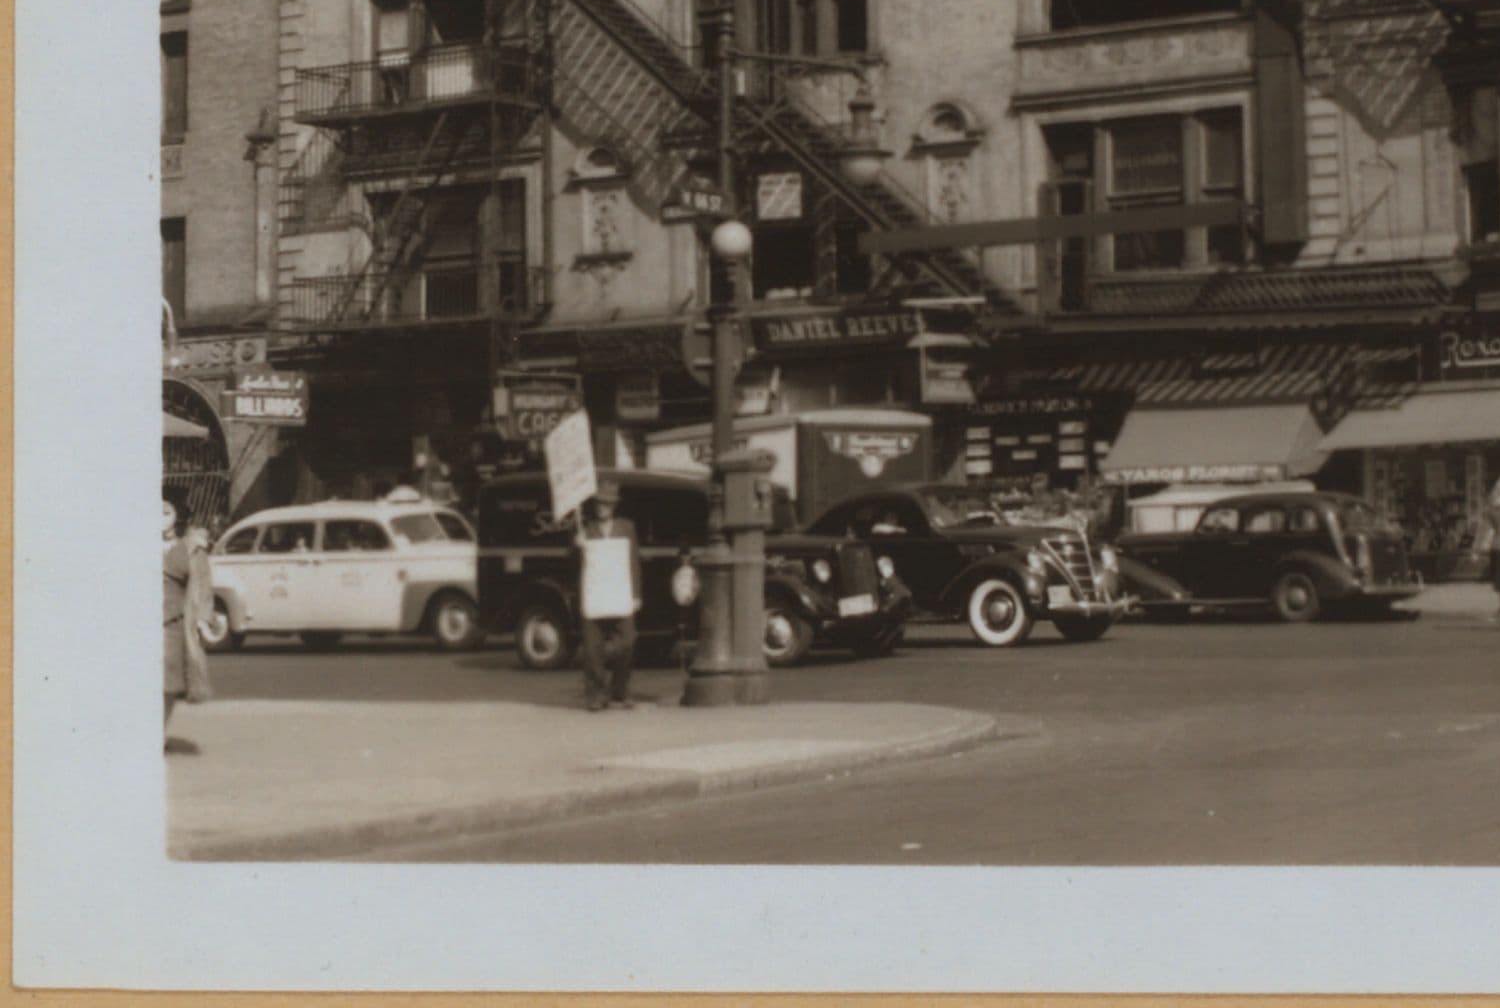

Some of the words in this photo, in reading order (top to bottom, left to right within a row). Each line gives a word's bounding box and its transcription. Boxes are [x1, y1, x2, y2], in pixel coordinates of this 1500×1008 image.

[767, 317, 842, 342] DANIEL
[846, 313, 918, 337] REEVE
[1190, 463, 1258, 481] FLORIST
